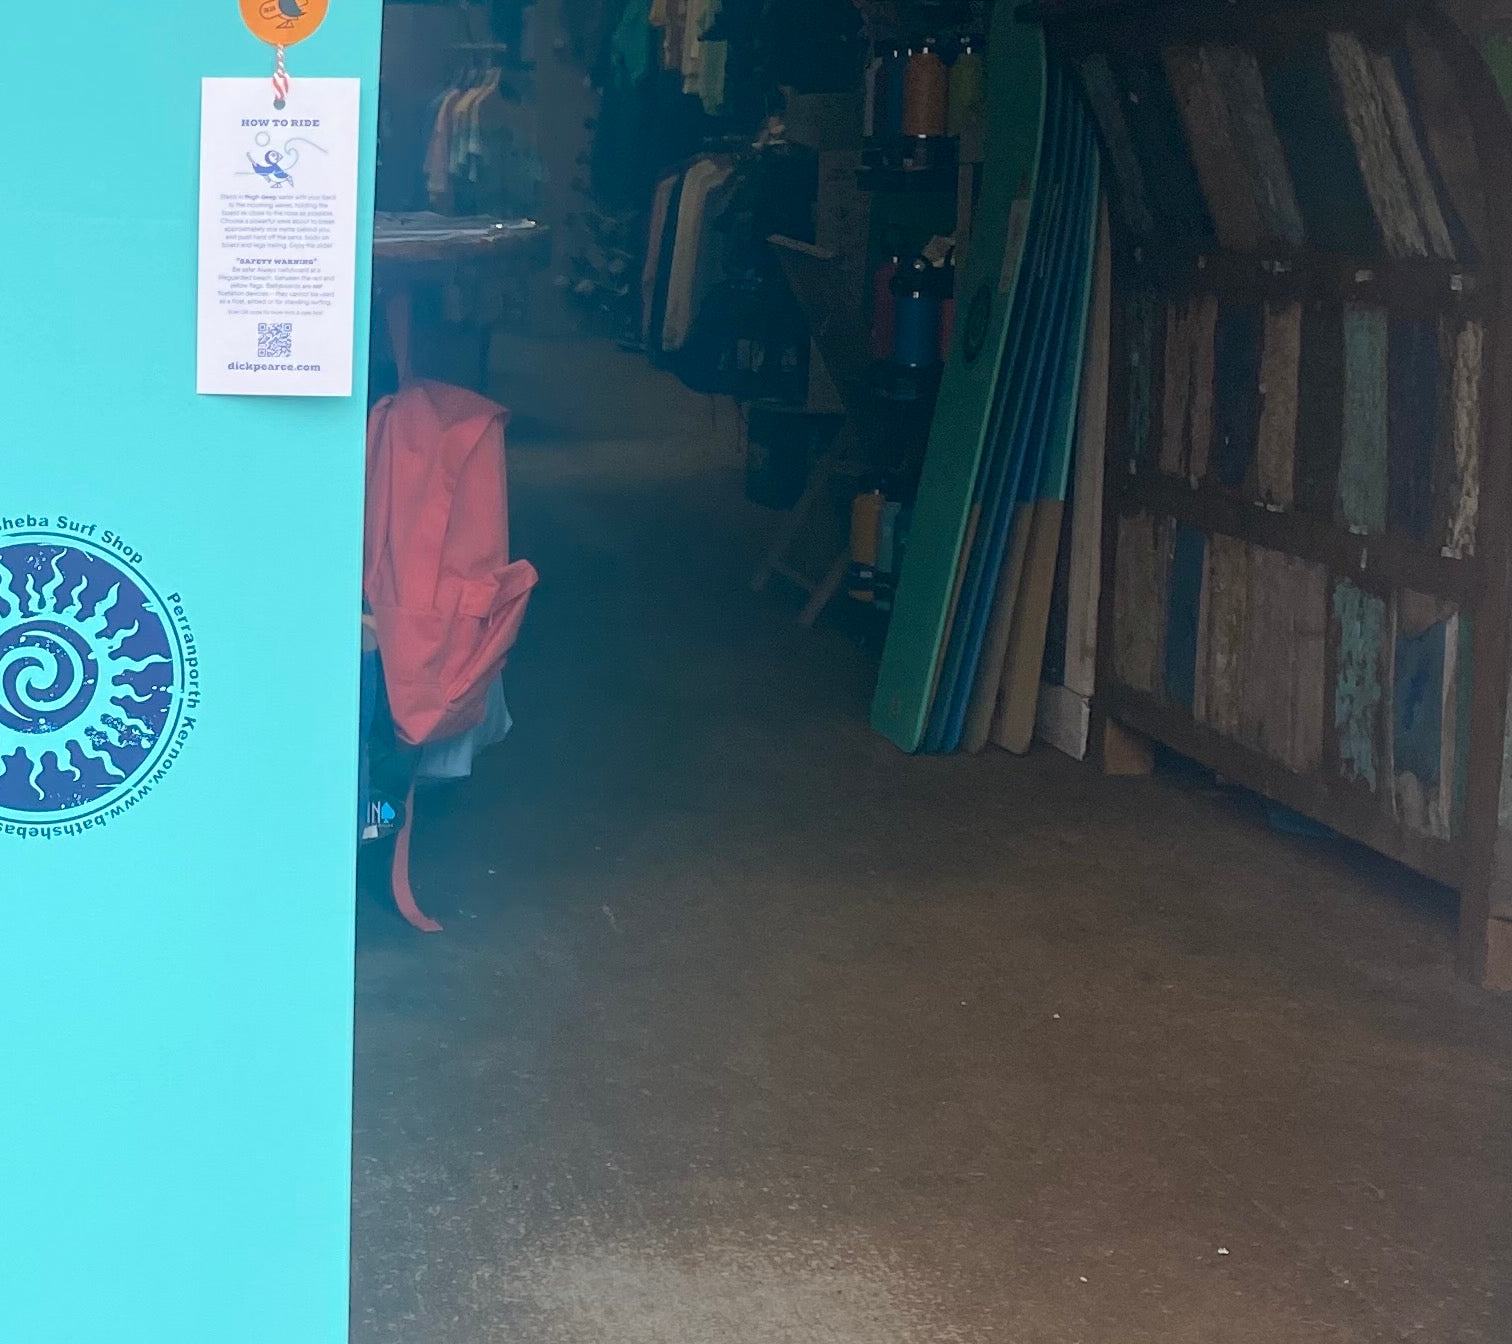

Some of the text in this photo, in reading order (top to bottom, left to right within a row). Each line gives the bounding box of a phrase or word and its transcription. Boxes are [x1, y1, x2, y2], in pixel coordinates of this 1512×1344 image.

[241, 119, 320, 127] HOW TO RIDE
[227, 361, 321, 373] dickpearce.com
[56, 515, 97, 537] Surf
[101, 529, 143, 564] Shop
[167, 592, 201, 709] Perranporth
